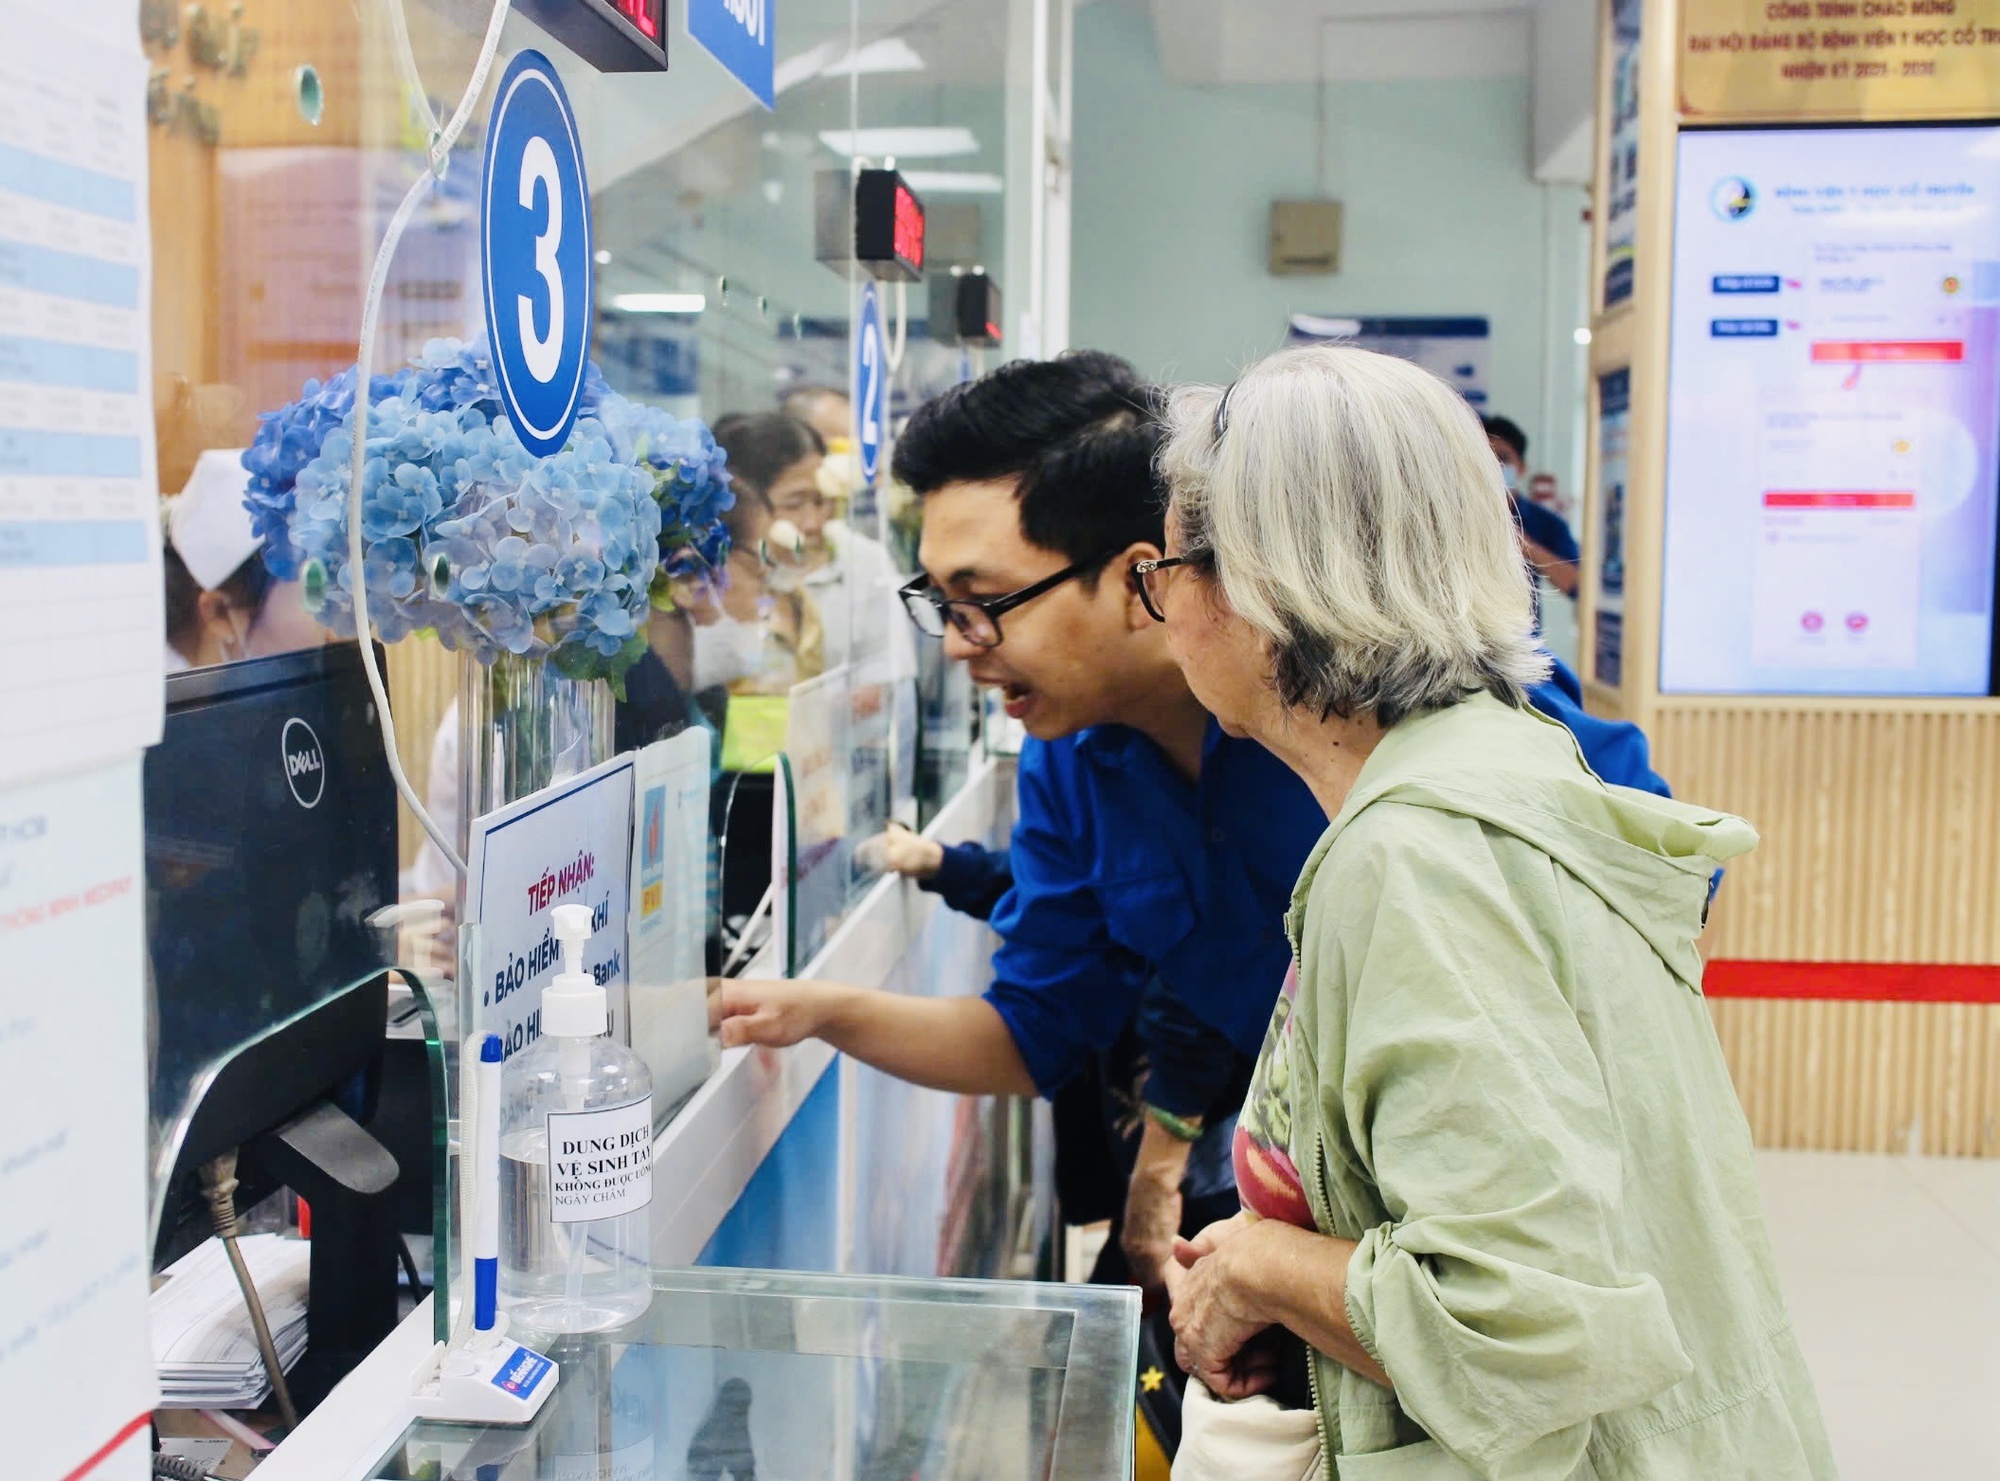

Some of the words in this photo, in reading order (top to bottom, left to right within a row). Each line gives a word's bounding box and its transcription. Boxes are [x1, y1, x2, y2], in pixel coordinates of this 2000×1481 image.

[518, 135, 564, 384] 3
[863, 324, 878, 445] 2
[288, 749, 321, 777] DELL
[528, 866, 556, 916] TIẾP
[558, 849, 595, 898] NHẬN:
[495, 951, 525, 1005] BẢO
[528, 927, 560, 981] HIỂM
[500, 1019, 524, 1063] ẢO
[594, 948, 620, 986] Bank
[557, 1160, 583, 1180] VỆ
[588, 1153, 629, 1175] SINH
[562, 1136, 615, 1156] DUNG
[620, 1124, 649, 1149] DỊCH
[555, 1179, 601, 1192] KHÔNG
